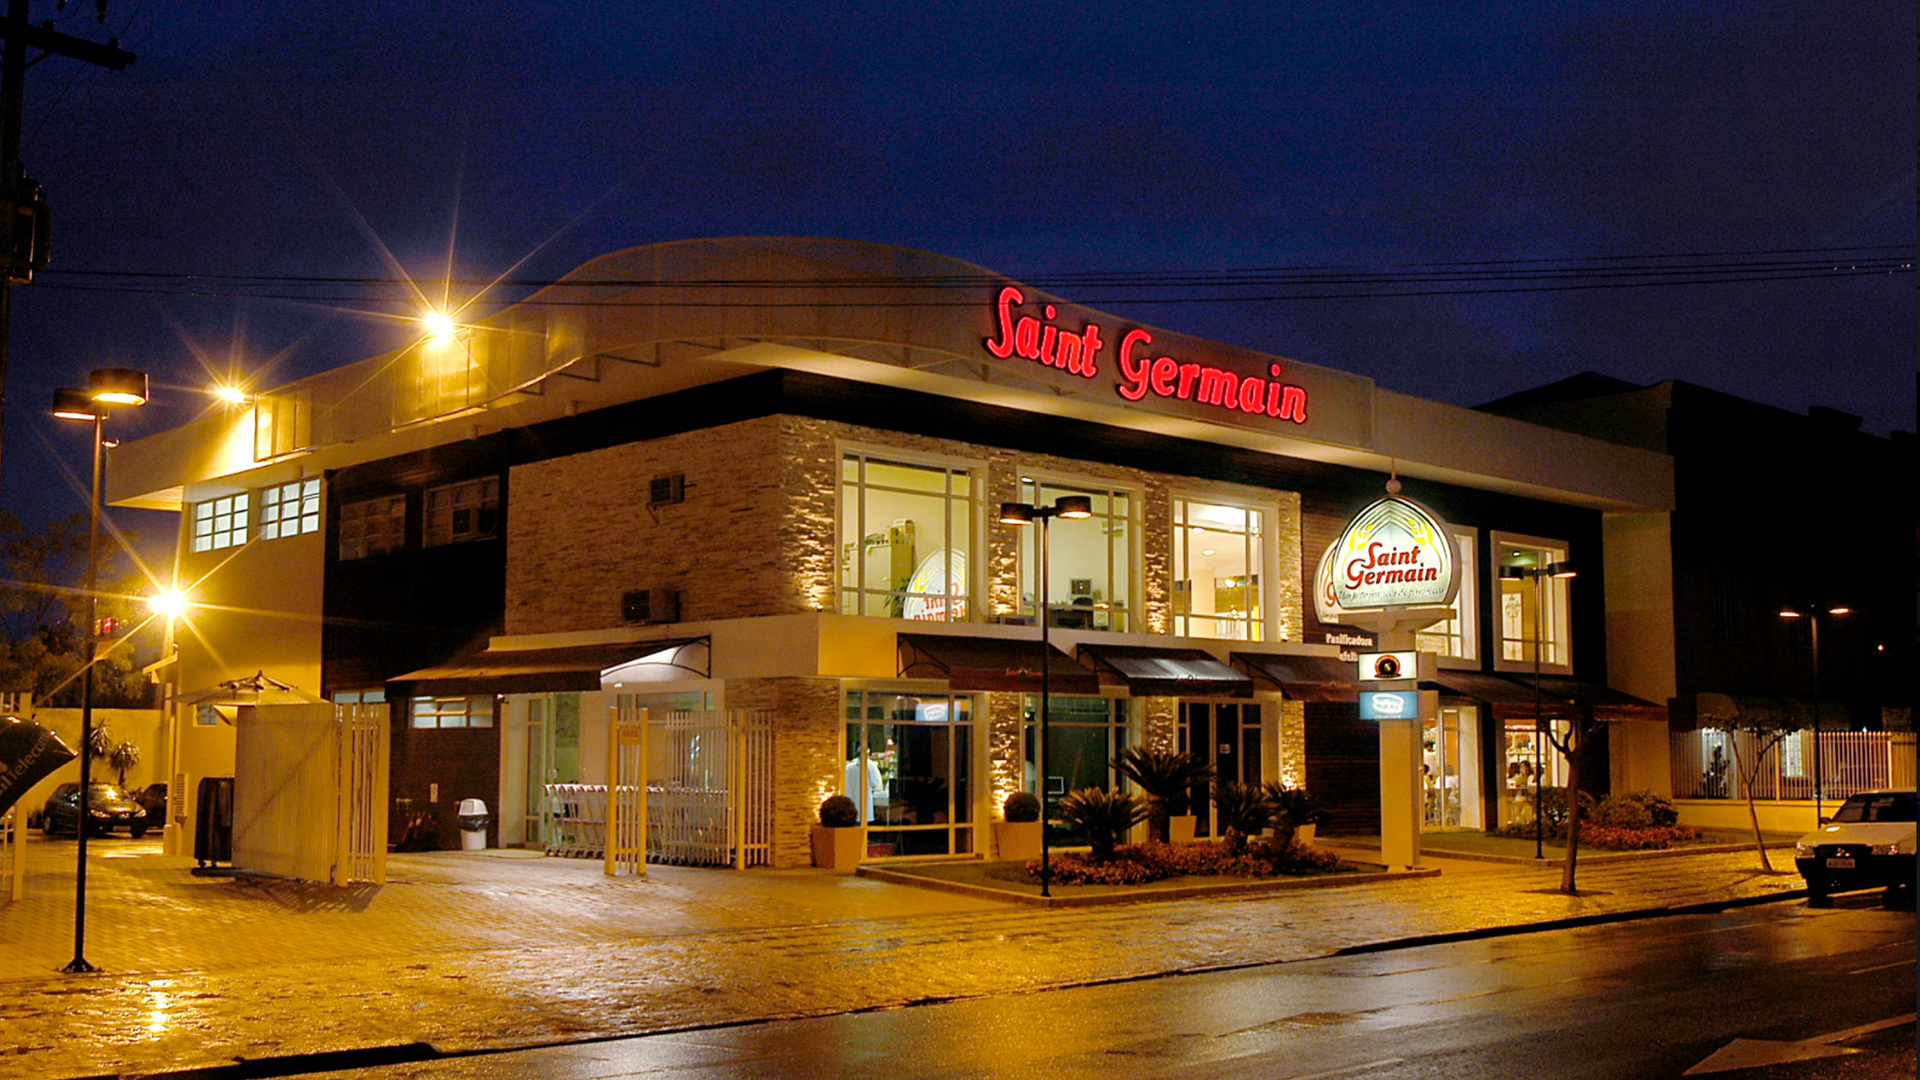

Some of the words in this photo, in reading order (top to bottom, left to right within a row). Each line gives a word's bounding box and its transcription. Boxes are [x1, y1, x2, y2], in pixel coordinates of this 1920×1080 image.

[986, 285, 1103, 379] Saint
[1118, 328, 1307, 424] Germain
[1361, 542, 1421, 569] Saint
[1345, 562, 1437, 590] Germain
[1325, 633, 1373, 646] Panificadora
[8, 733, 51, 780] Telecom
